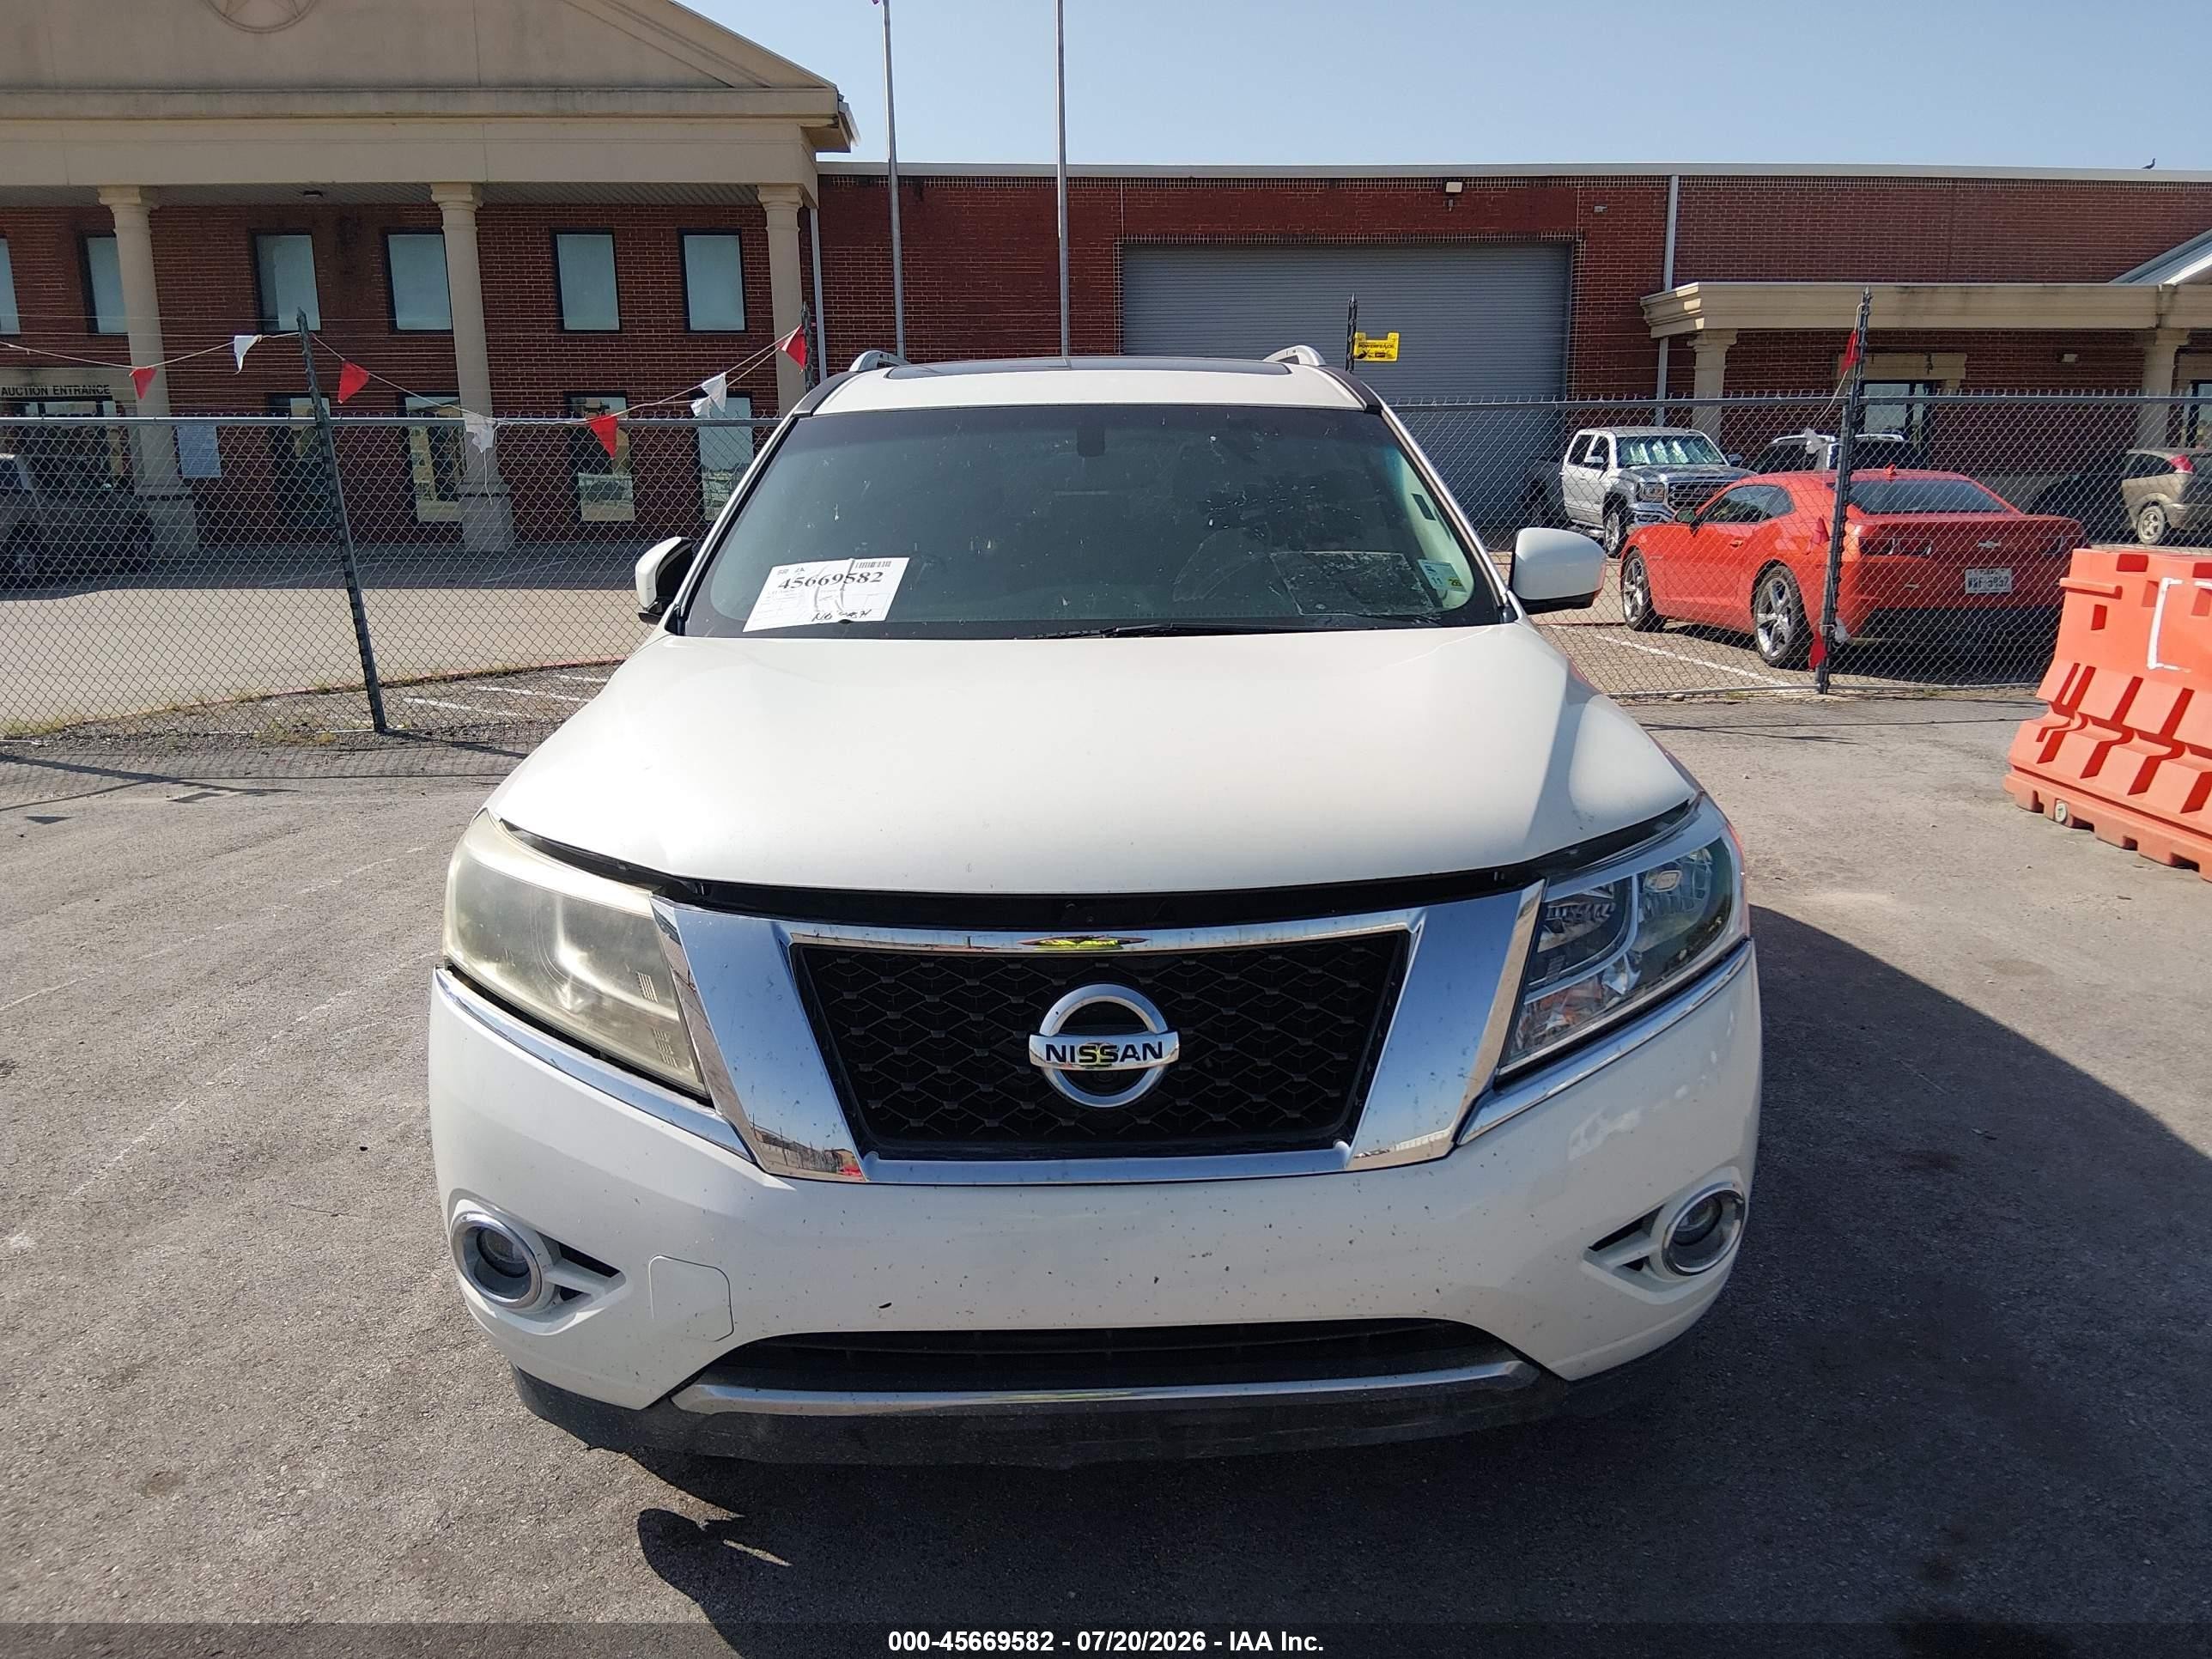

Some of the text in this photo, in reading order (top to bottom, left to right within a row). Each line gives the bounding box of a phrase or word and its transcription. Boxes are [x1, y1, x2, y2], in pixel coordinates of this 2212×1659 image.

[2, 385, 110, 396] AUCTION ENTRANCE
[778, 571, 884, 589] 45669582
[1045, 1042, 1163, 1062] NISSAN
